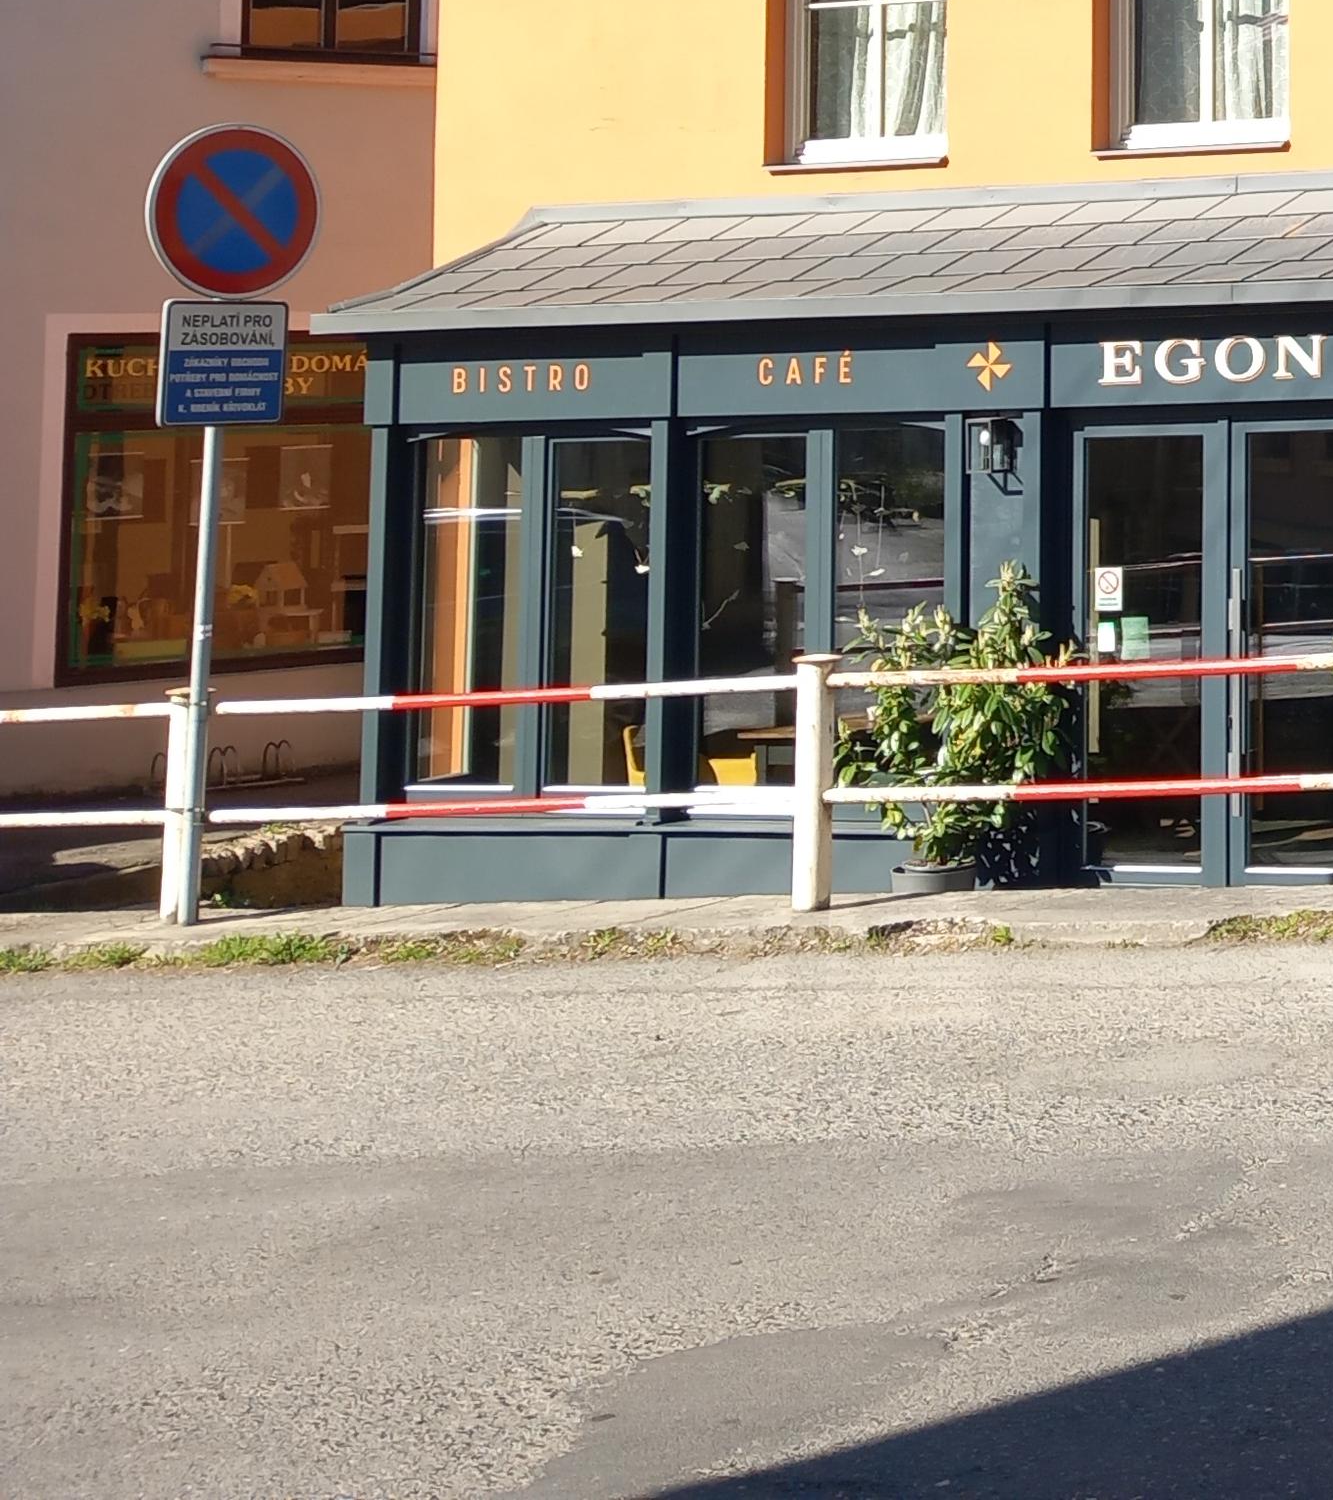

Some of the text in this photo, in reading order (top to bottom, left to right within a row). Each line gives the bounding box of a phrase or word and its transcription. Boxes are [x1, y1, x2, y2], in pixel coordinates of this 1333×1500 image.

[181, 311, 273, 329] NEPLATÍ PRO
[180, 329, 275, 347] ZÁSOBOVÁNÍ,
[757, 350, 852, 386] CAFÉ
[1098, 334, 1328, 386] EGON
[452, 363, 590, 394] BISTRO
